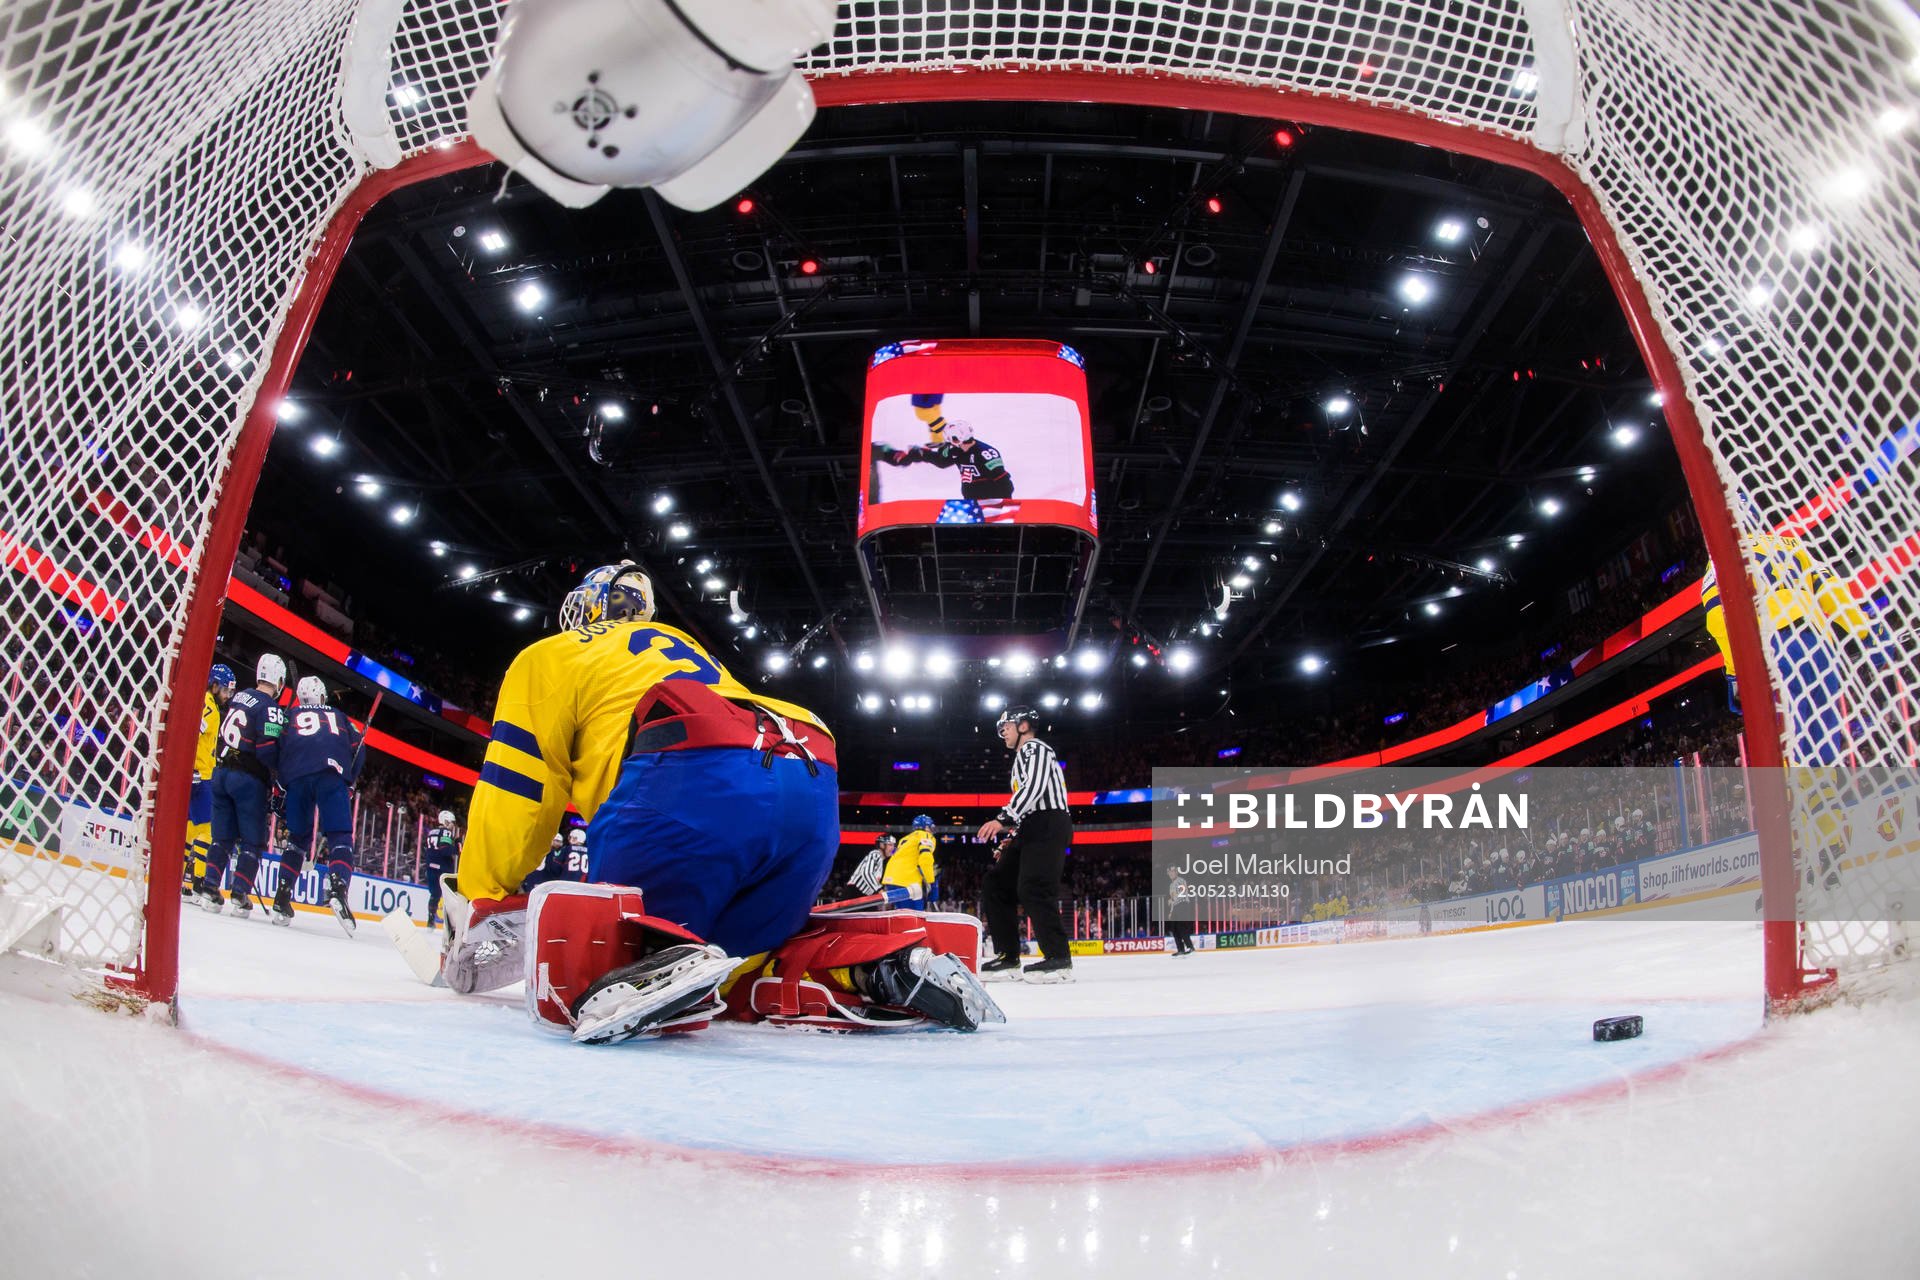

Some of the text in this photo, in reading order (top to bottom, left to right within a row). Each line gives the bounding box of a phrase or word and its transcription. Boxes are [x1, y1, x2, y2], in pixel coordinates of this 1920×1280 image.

[267, 706, 284, 725] 56
[296, 711, 340, 736] 91
[568, 852, 589, 873] 20
[1642, 850, 1759, 890] shop.iihfworlds.com
[251, 859, 319, 904] NOCO
[1563, 873, 1618, 915] NOCCO
[365, 882, 412, 913] iLOQ
[1485, 895, 1526, 923] iLOQ
[1115, 939, 1164, 951] STRAUSS
